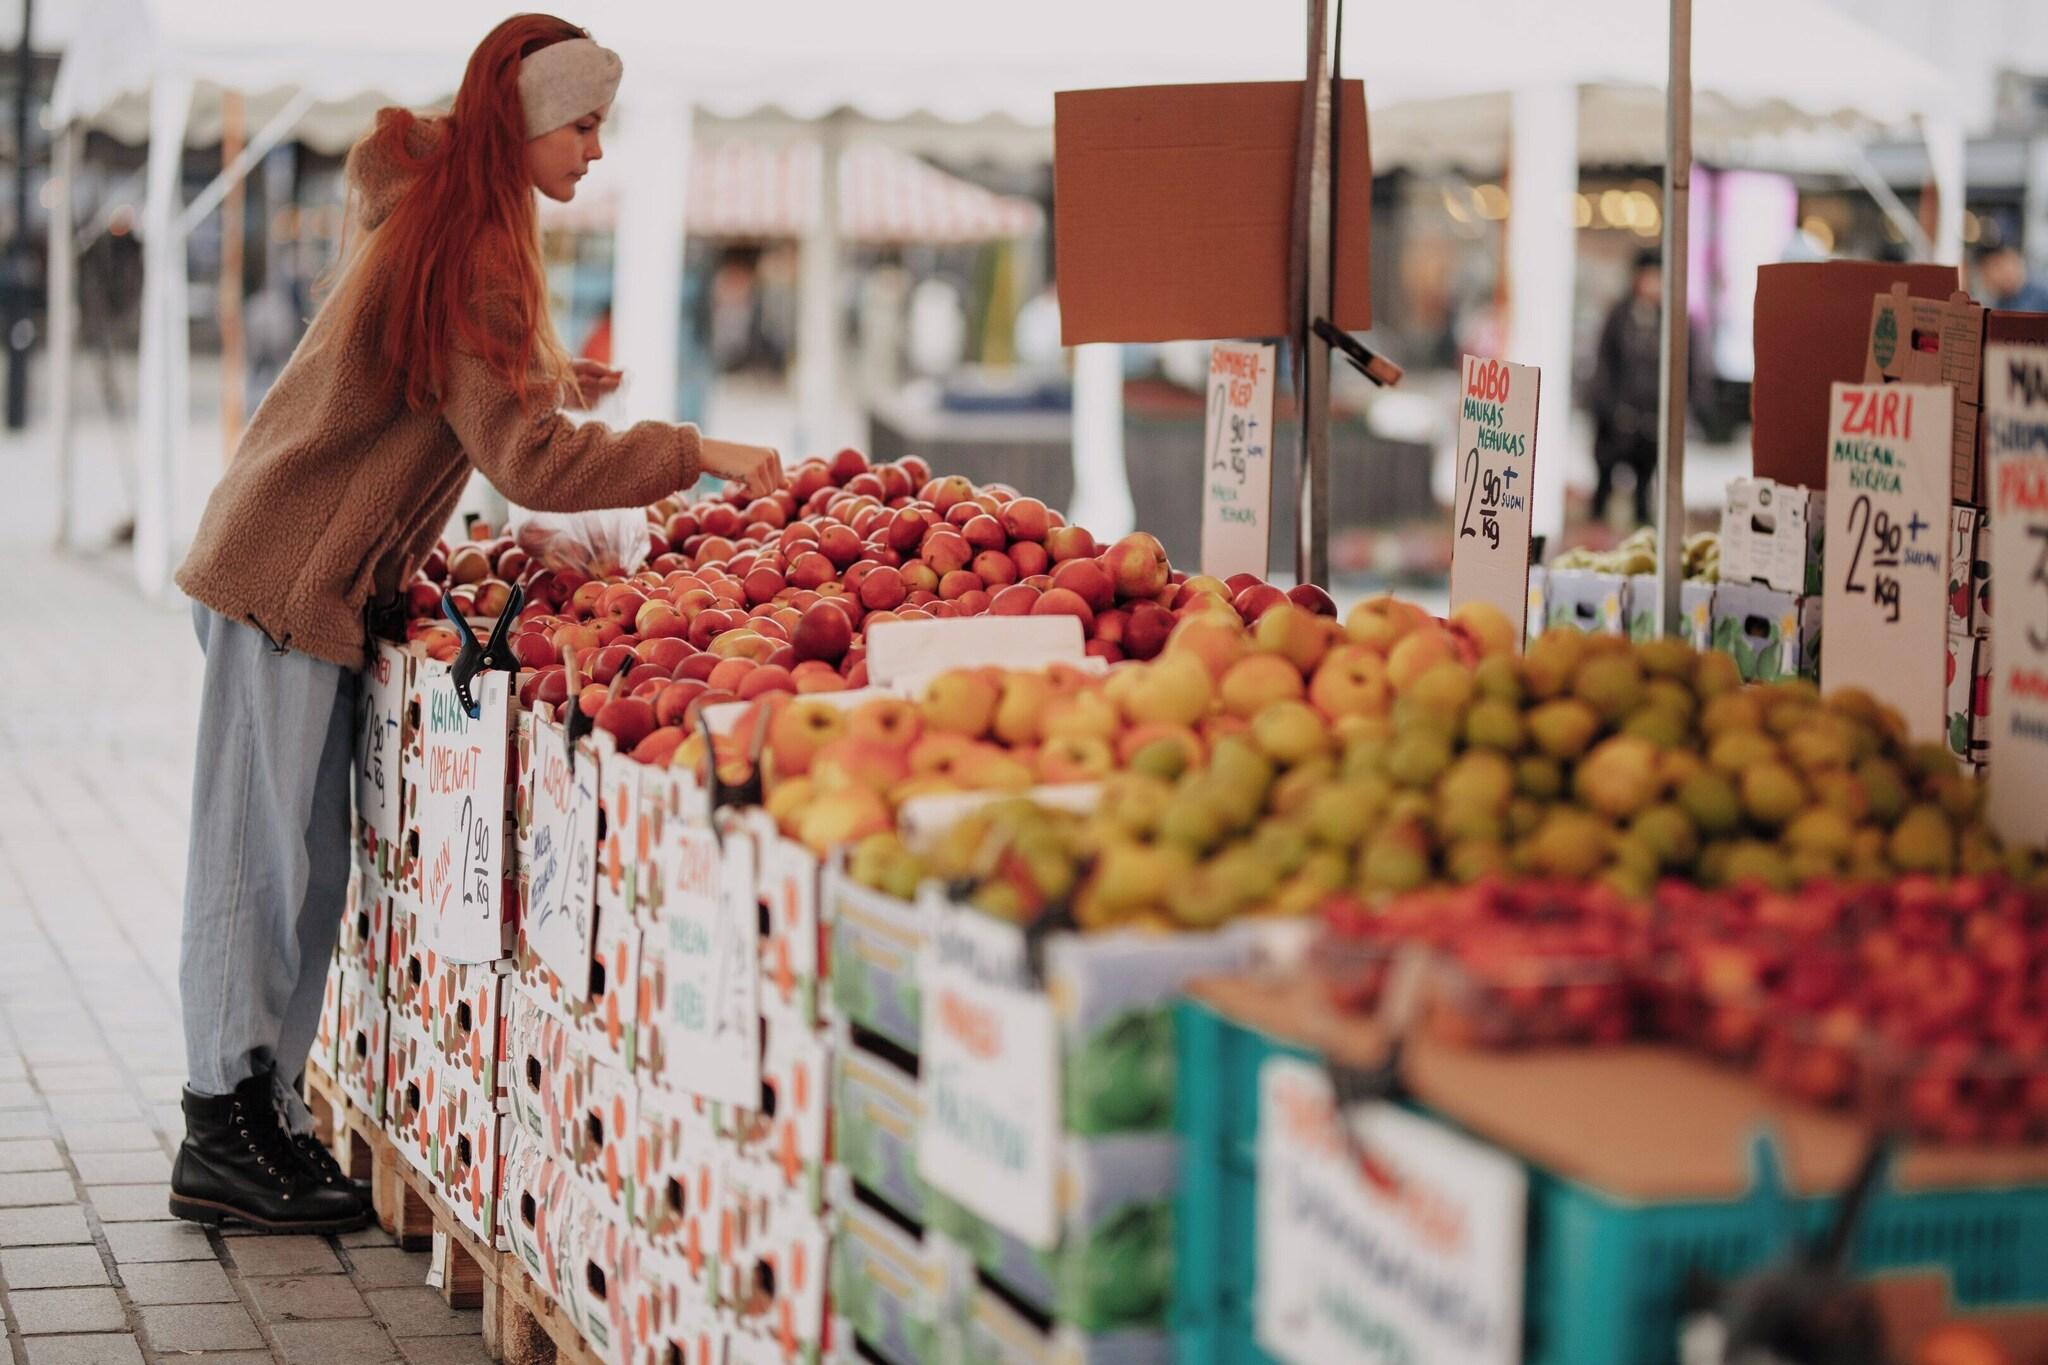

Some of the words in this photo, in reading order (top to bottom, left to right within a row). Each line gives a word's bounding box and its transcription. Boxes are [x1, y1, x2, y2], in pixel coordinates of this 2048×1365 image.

[1468, 359, 1510, 404] LOBO
[1464, 397, 1504, 429] MAUKAS
[1841, 390, 1914, 441] ZARI
[1477, 424, 1525, 457] MEHUKAS
[1460, 447, 1480, 539] 2
[1481, 469, 1501, 508] 90
[1501, 492, 1525, 512] SUOMI
[1844, 495, 1871, 594] 2
[1874, 509, 1902, 555] 90
[429, 746, 481, 794] OMENAT
[430, 836, 450, 905] VAIN
[461, 795, 473, 908] 2
[475, 817, 489, 862] 90
